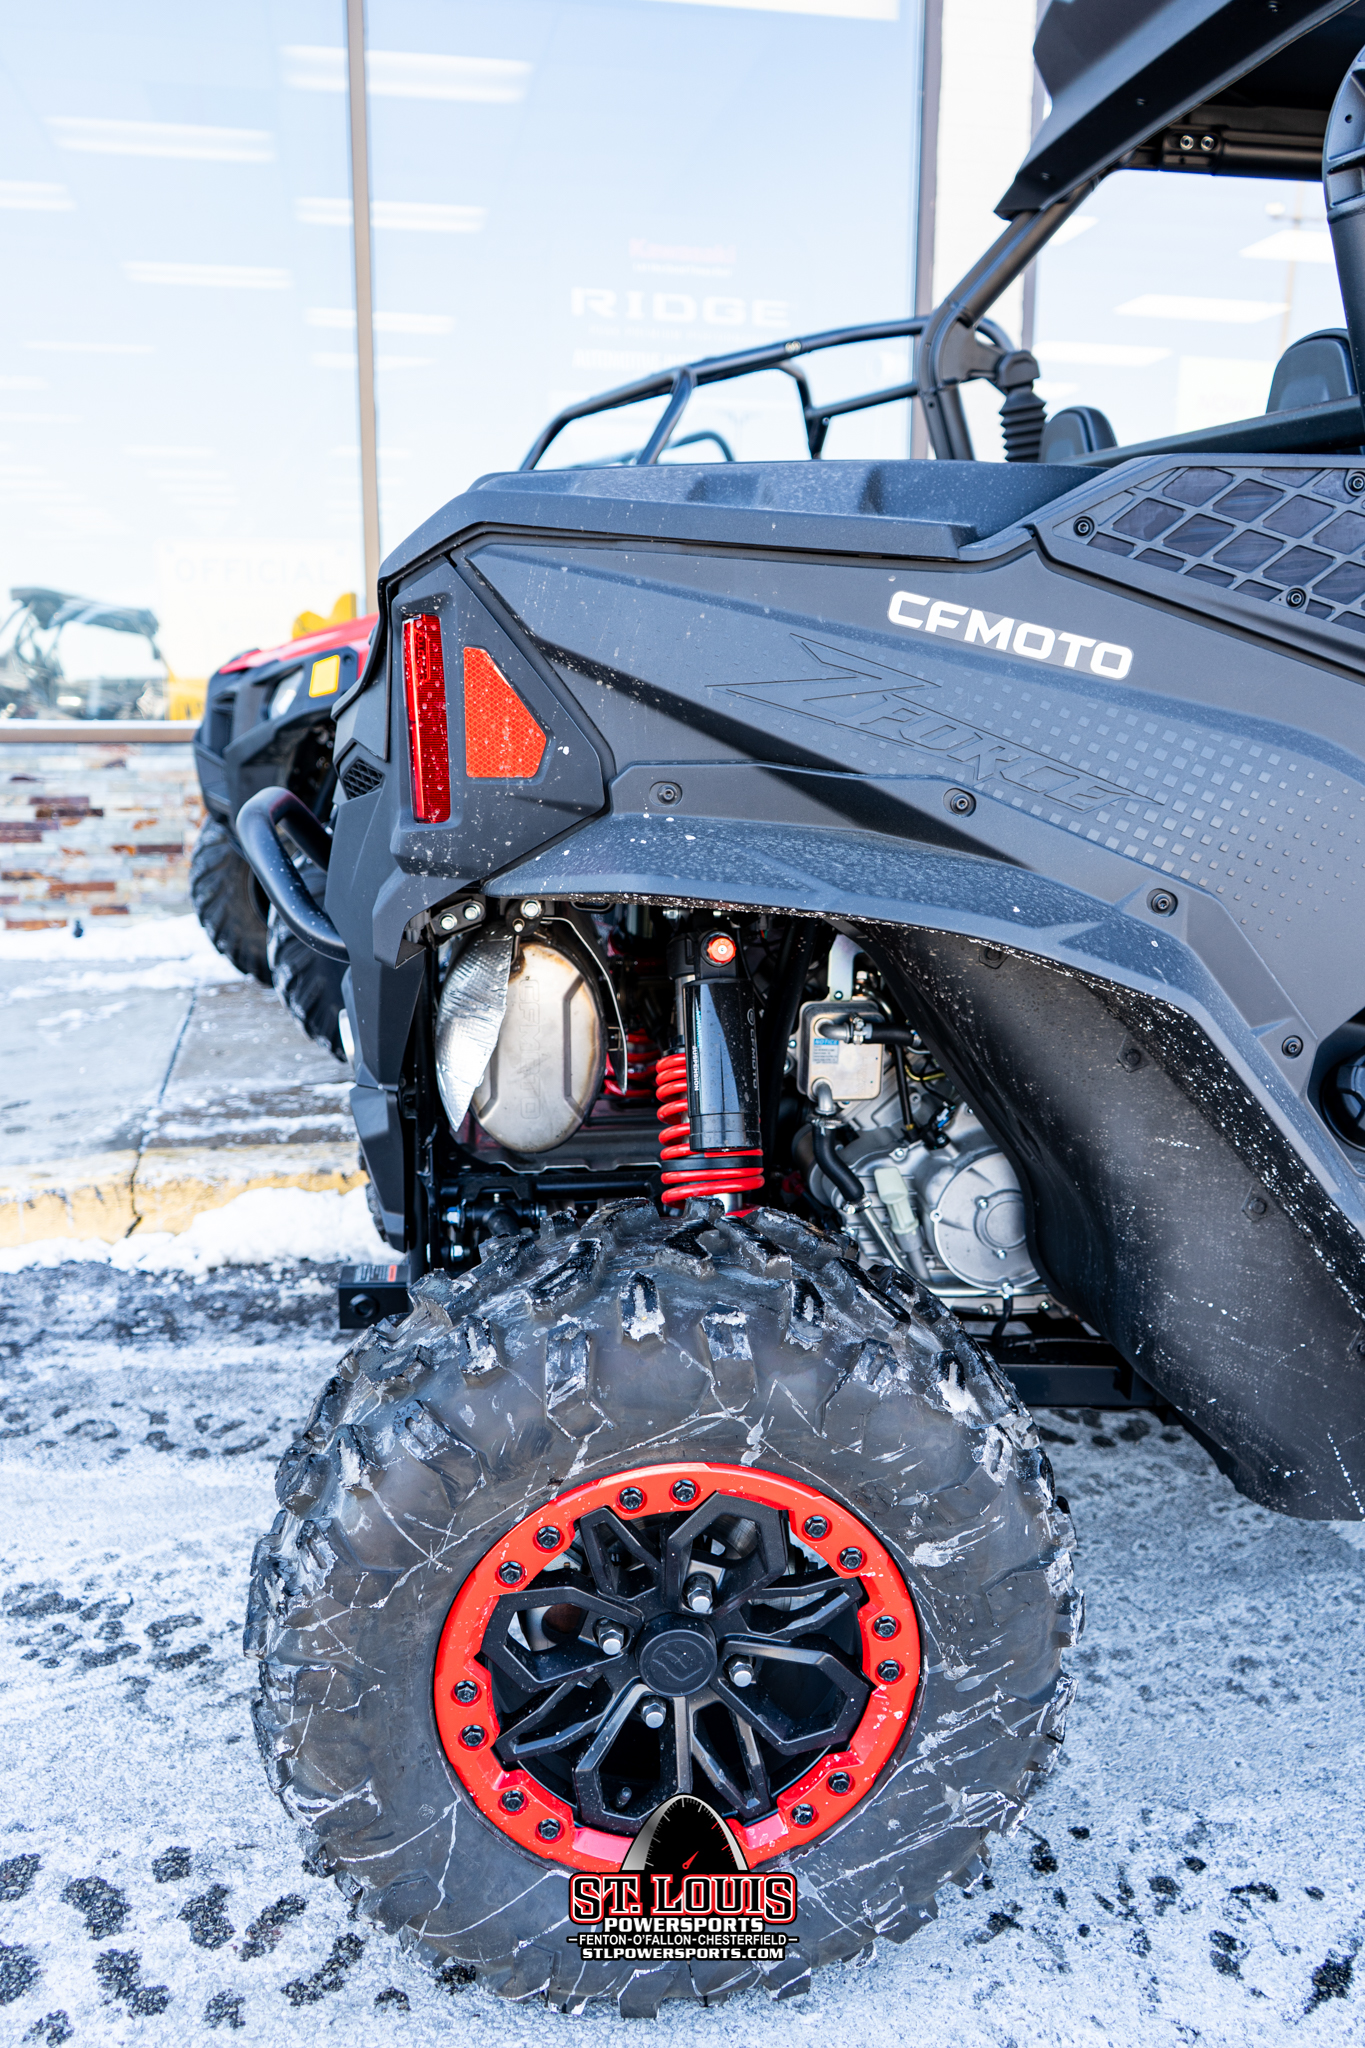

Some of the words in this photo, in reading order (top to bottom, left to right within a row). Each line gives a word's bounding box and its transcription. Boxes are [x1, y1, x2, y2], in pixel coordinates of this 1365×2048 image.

[571, 286, 792, 329] RIDGE
[174, 556, 338, 586] OFFICIAL
[888, 590, 1133, 680] CFMOTO
